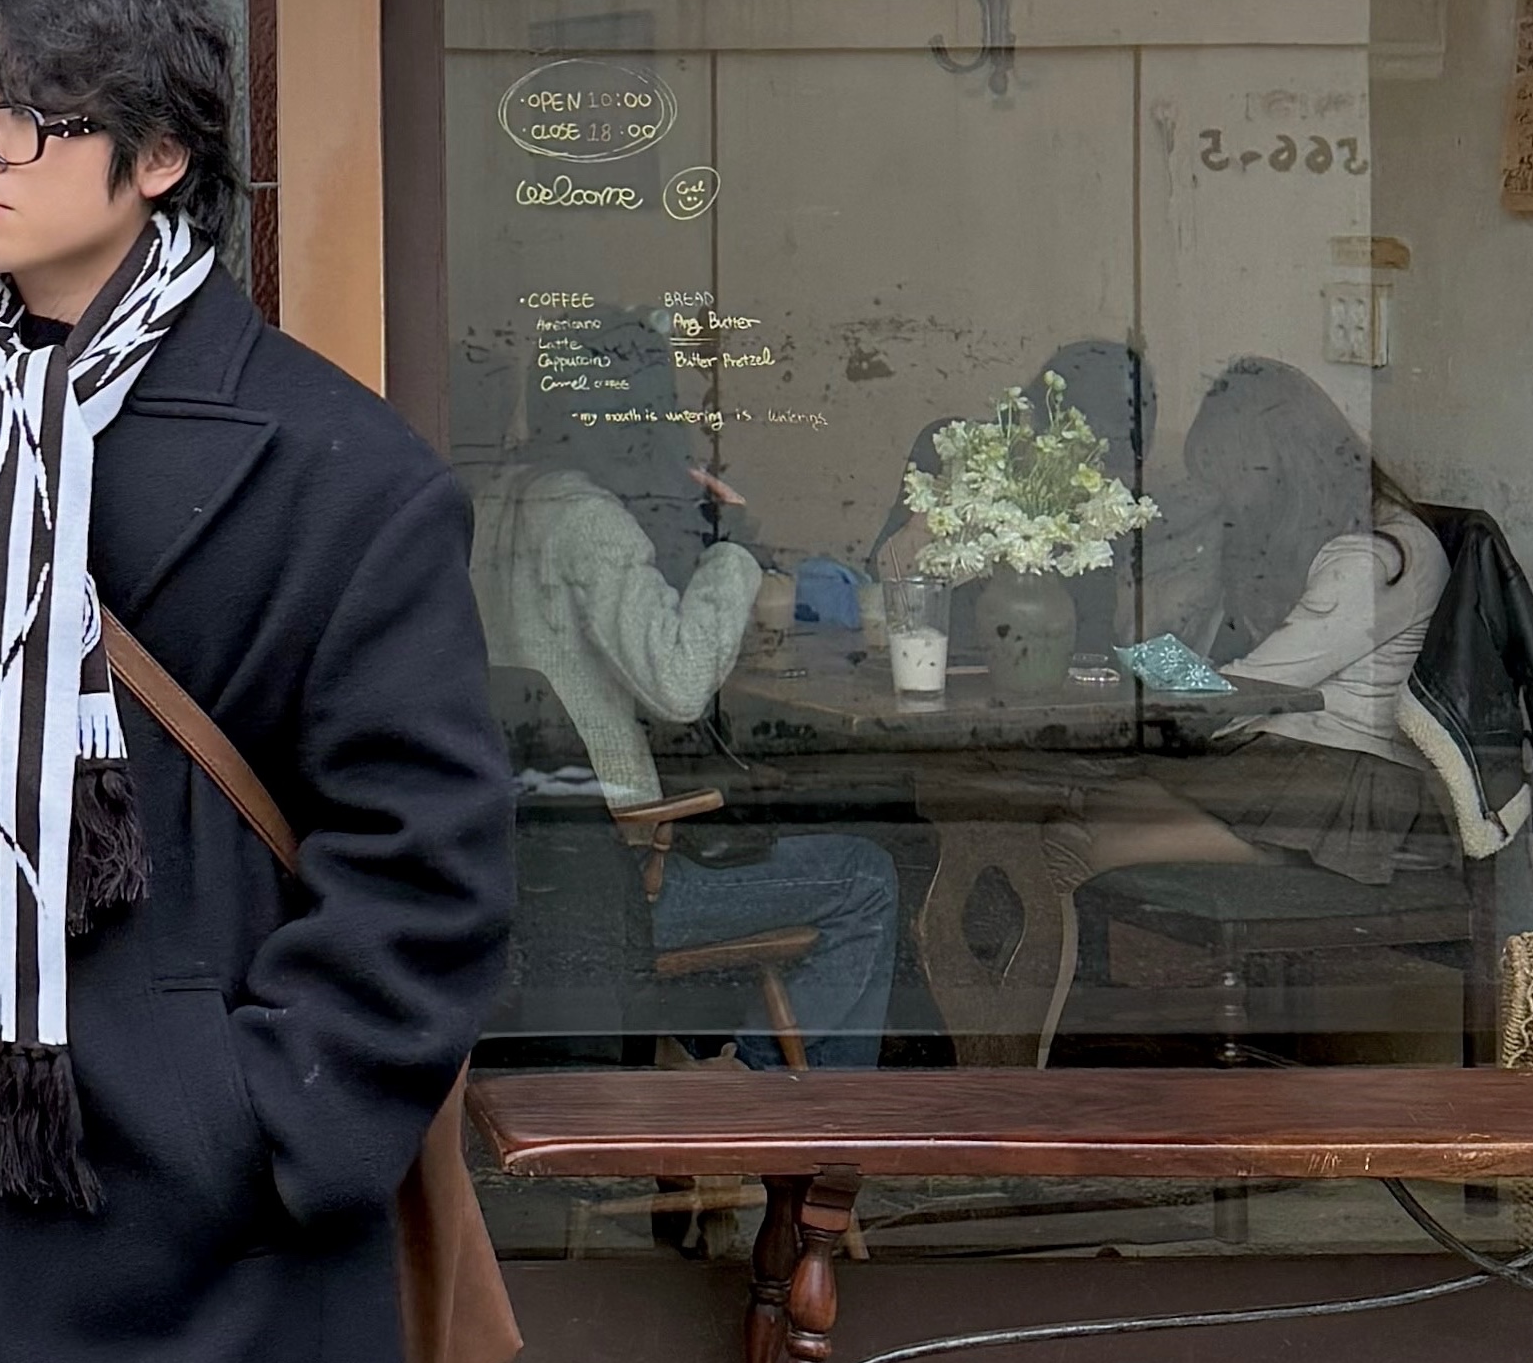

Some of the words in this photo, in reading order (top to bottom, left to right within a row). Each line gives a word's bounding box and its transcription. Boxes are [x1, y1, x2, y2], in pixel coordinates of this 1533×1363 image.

[528, 90, 581, 112] OPEN
[586, 92, 652, 109] 10:00
[531, 122, 581, 140] CLOSE
[528, 293, 594, 308] COFFEE
[664, 291, 715, 307] BREAD
[723, 346, 776, 368] Pretzel
[735, 409, 752, 422] is
